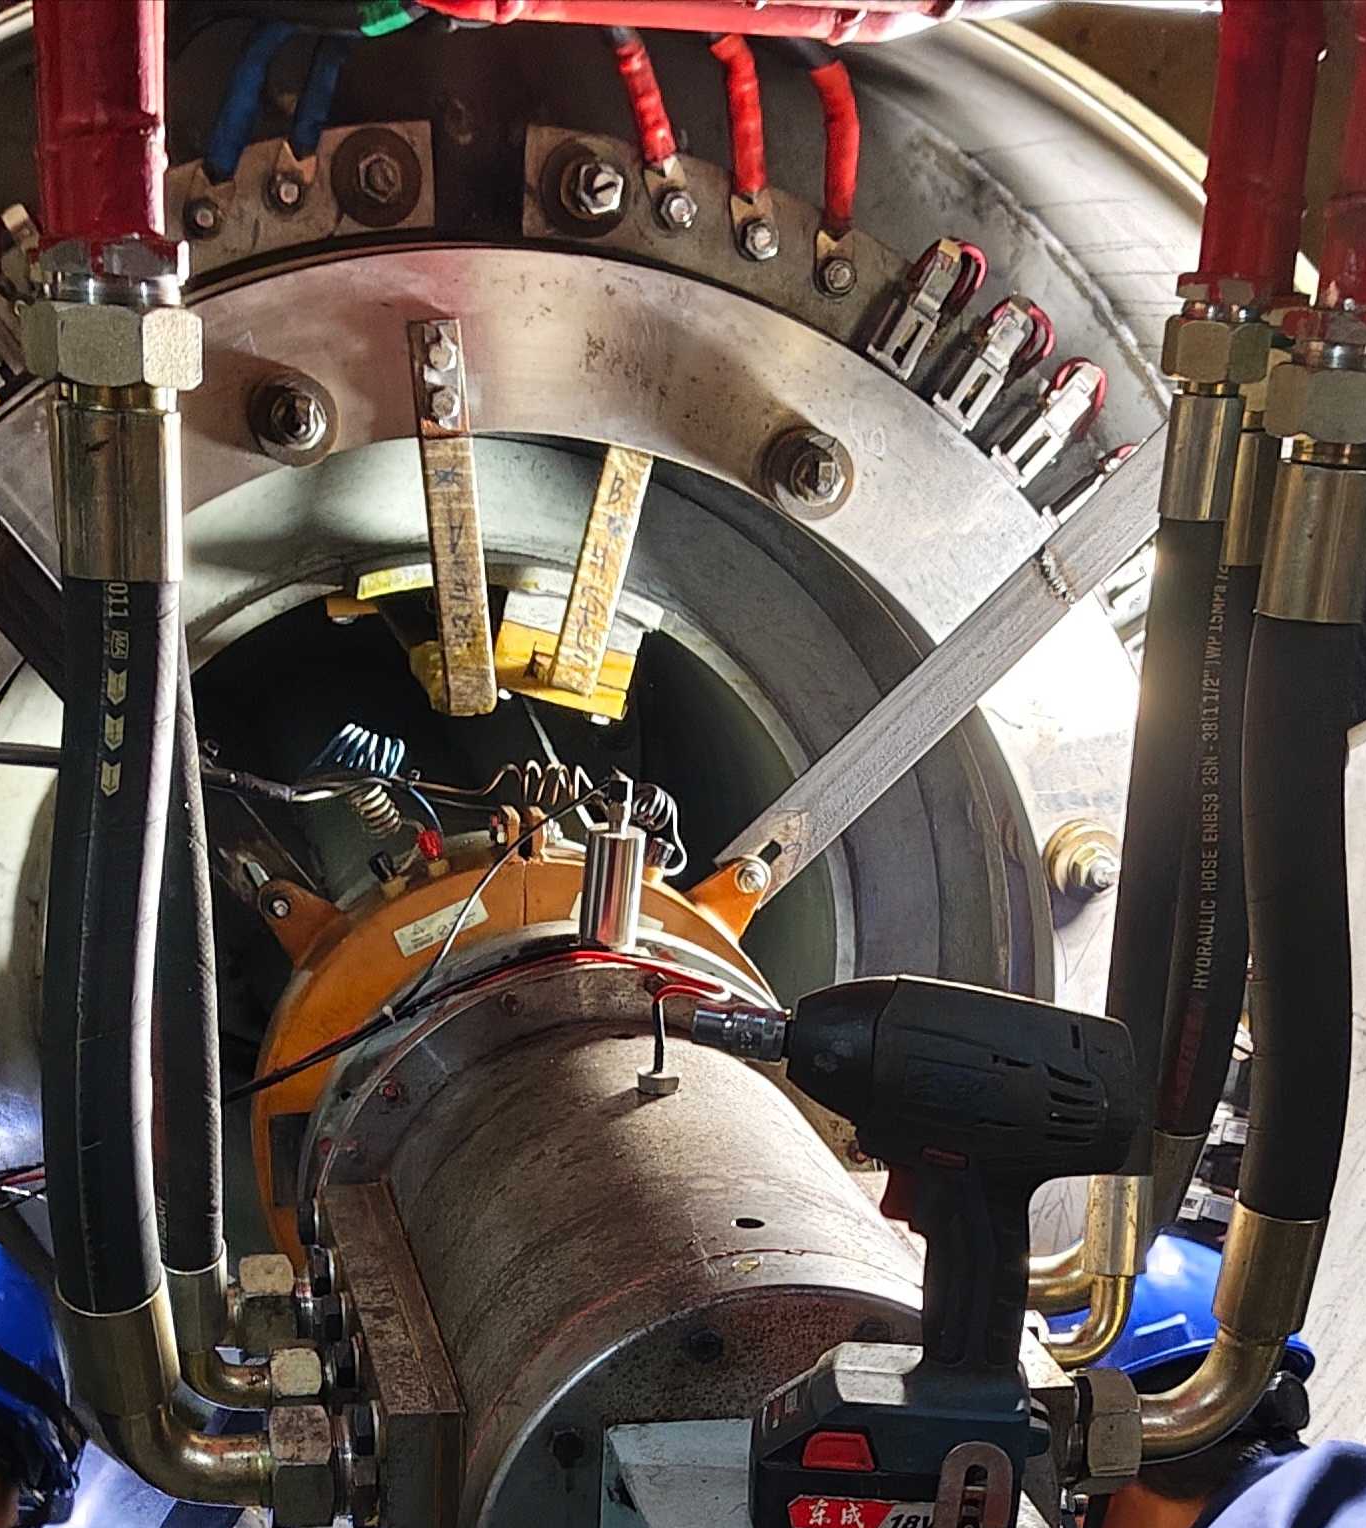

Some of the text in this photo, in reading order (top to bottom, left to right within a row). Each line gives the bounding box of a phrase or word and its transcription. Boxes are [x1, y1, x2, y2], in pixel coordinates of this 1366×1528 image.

[1201, 755, 1219, 785] 2SN
[1202, 793, 1219, 842] EN853
[1201, 849, 1218, 891] HOSE
[1191, 899, 1217, 990] HYDRAULIC
